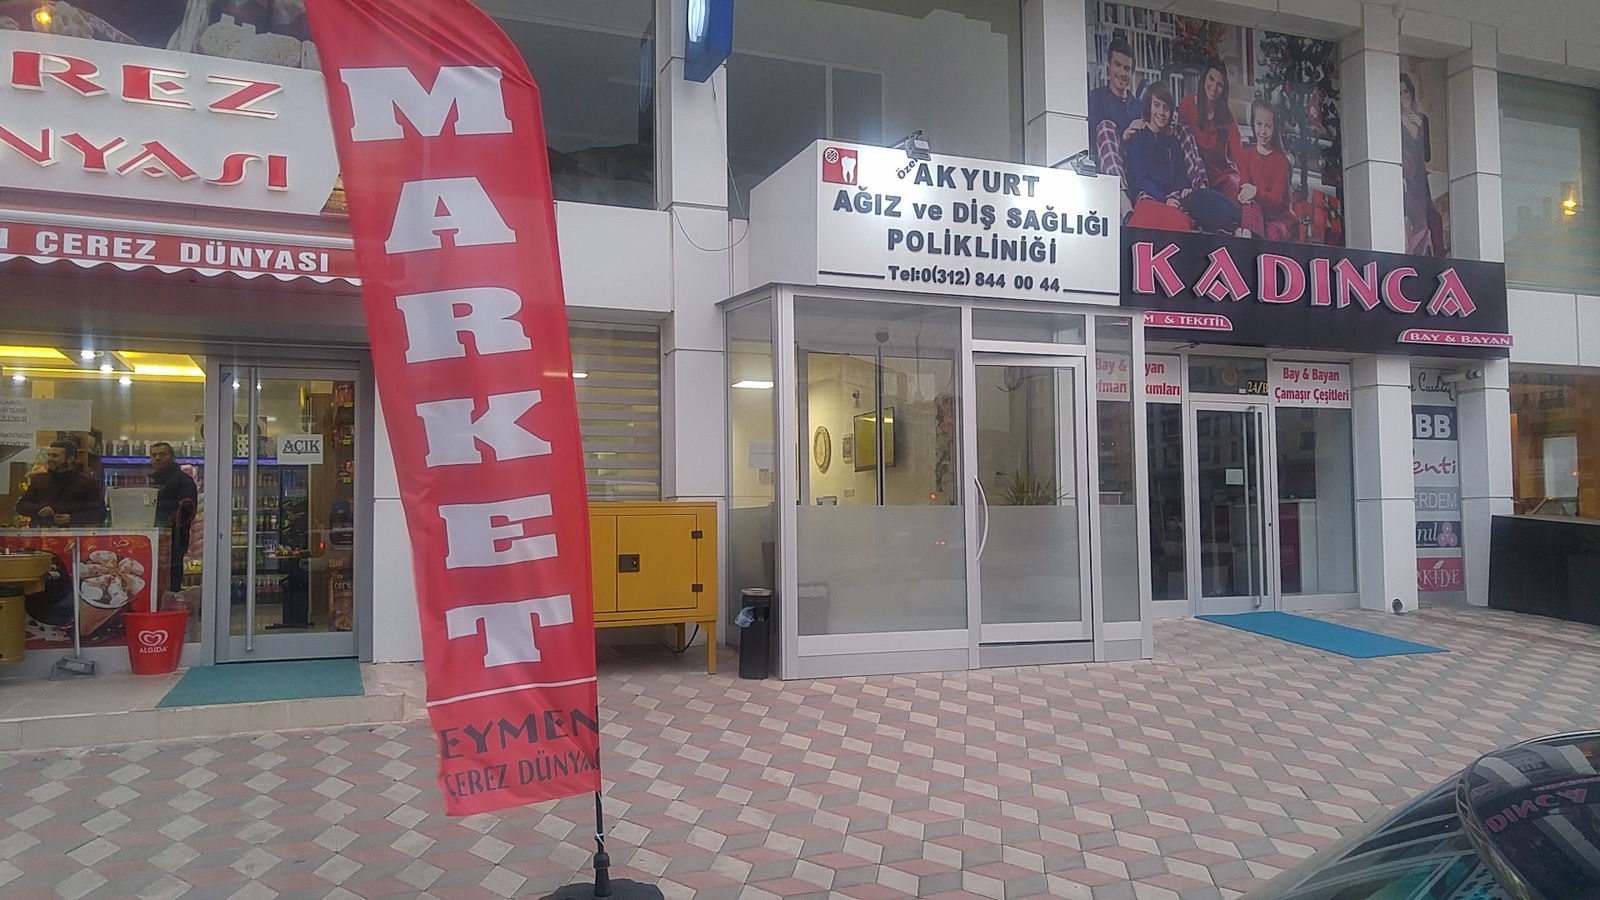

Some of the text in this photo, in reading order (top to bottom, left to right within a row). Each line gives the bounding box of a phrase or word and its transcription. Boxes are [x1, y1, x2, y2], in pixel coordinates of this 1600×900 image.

[913, 162, 1040, 198] AKYURT
[833, 186, 1109, 238] AĞIZ ve DİŞ SAĞLIĞI
[35, 230, 157, 261] ÇEREZ
[180, 240, 330, 273] DÜNYASI
[887, 227, 1057, 265] POLİKLİNİĞİ
[888, 265, 1061, 293] Tel:0(312) 844 00 44
[1131, 241, 1478, 319] KADINCA
[1164, 315, 1175, 324] &
[1179, 314, 1227, 327] TEKSTİL
[1410, 332, 1510, 346] BAY & BAYAN
[339, 66, 574, 669] MARKET
[1118, 359, 1127, 372] &
[1282, 367, 1340, 385] Bay & Bayan
[1274, 386, 1350, 405] Çamaşır Çeşitleri
[282, 439, 321, 456] AÇIK
[1413, 456, 1457, 475] enti
[440, 704, 600, 760] EYMEN
[443, 763, 511, 804] ÇEREZ
